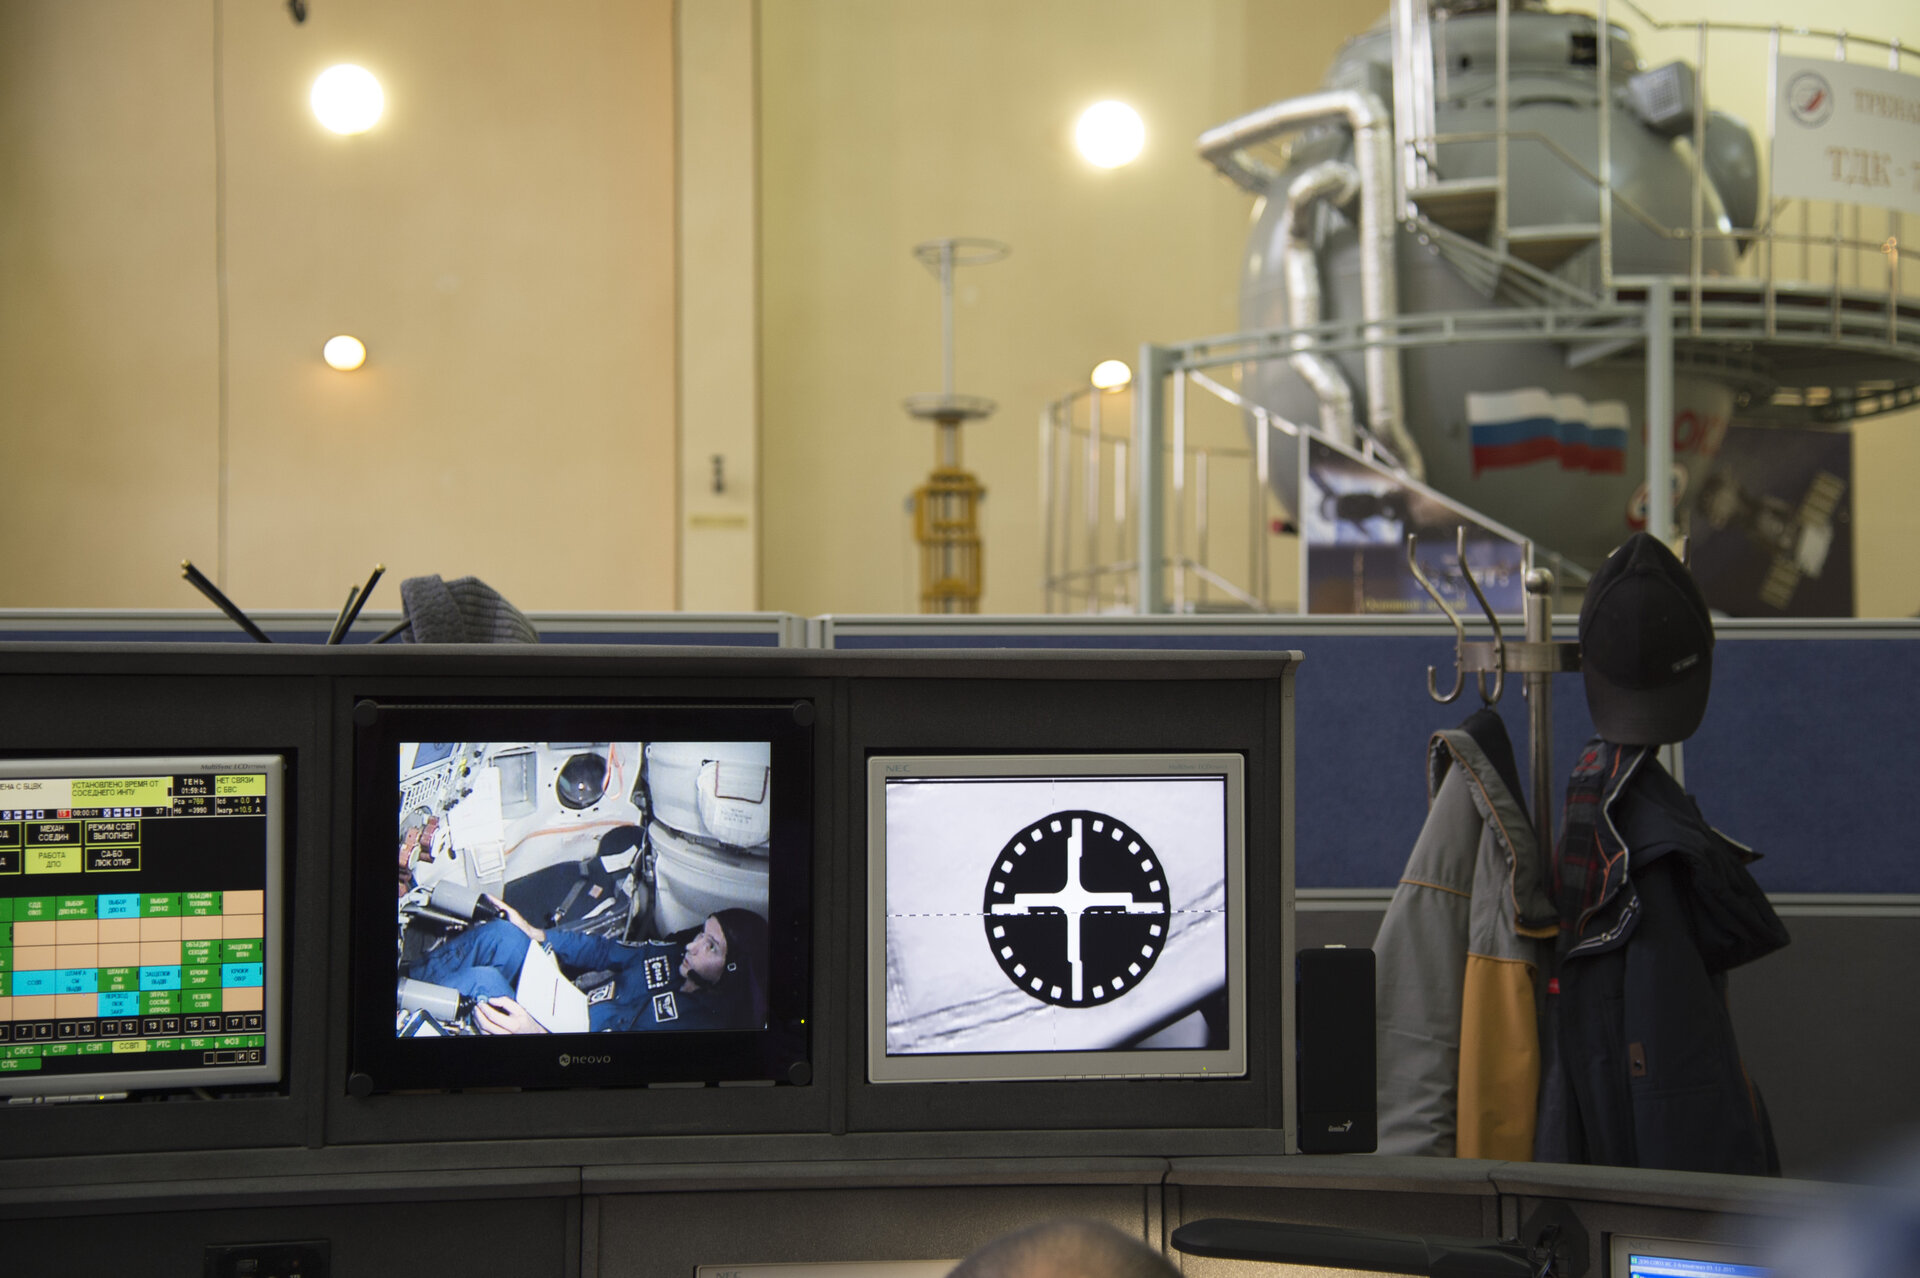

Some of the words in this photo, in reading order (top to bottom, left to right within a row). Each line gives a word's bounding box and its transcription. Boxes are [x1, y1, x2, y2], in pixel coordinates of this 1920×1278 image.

[885, 764, 911, 773] NEC
[72, 781, 123, 789] УСТАНОВЛЕНО
[125, 780, 148, 788] ВРЕМЯ
[72, 789, 115, 797] СОСЕДНЕГО
[40, 825, 64, 833] МЕХАН
[88, 823, 114, 831] РЕЖИМ
[94, 832, 133, 840] ВЫПОЛНЕН
[167, 1021, 175, 1029] 14
[209, 1019, 216, 1027] 16
[250, 1018, 258, 1026] 18
[119, 1041, 140, 1049] ССВП
[572, 1055, 611, 1064] neovo
